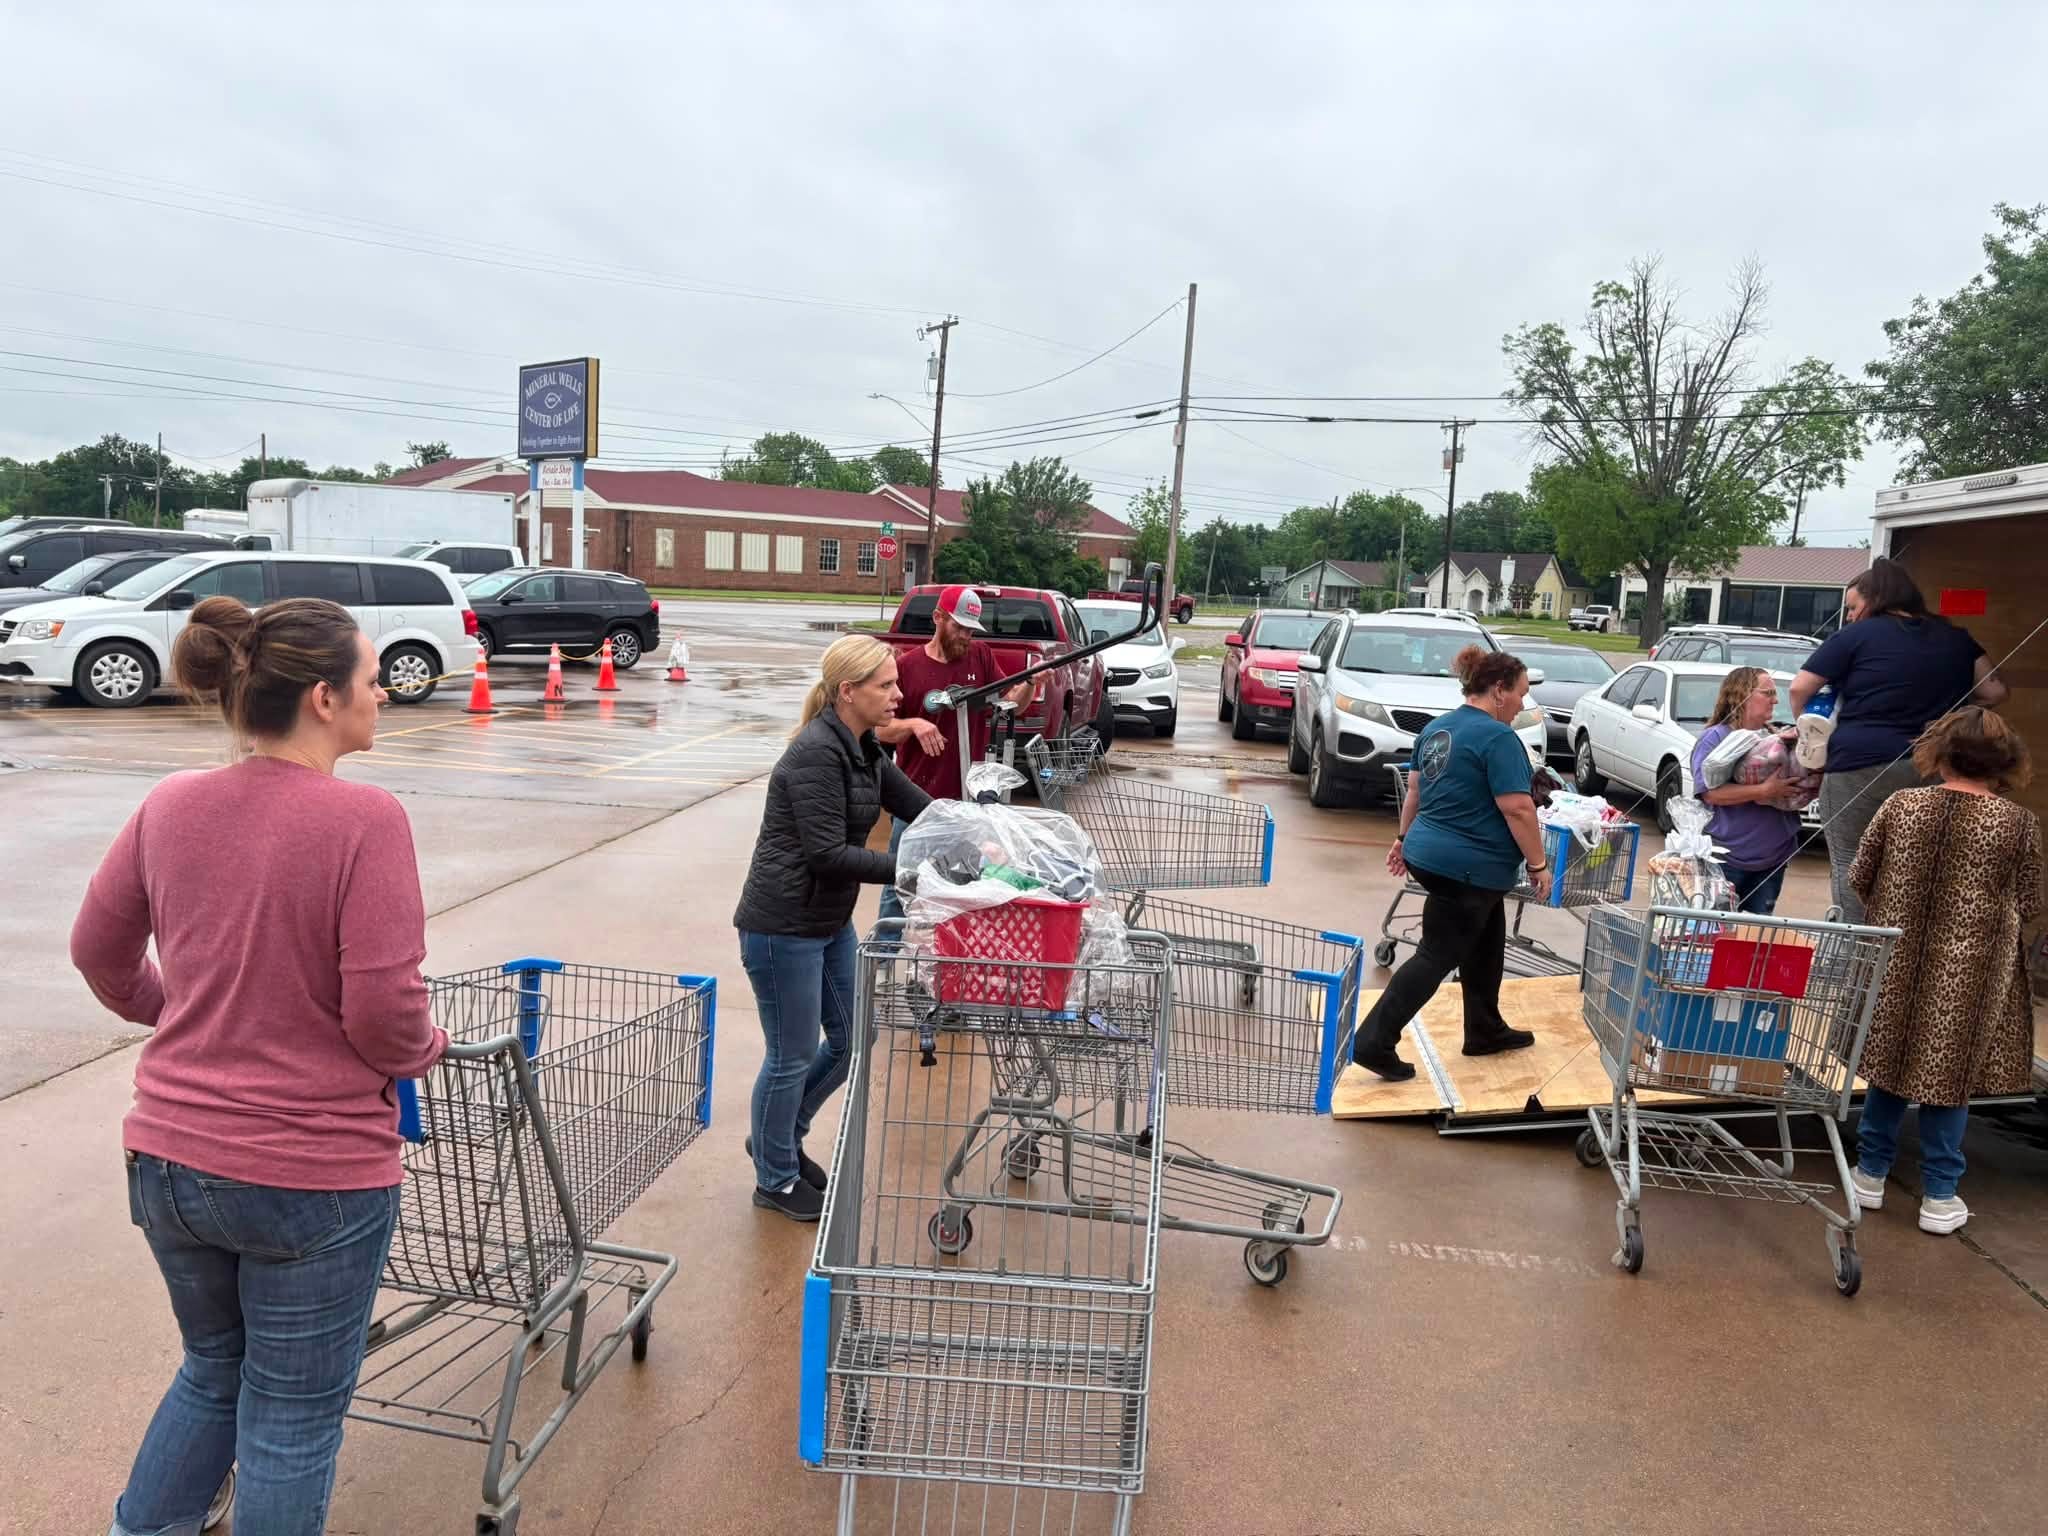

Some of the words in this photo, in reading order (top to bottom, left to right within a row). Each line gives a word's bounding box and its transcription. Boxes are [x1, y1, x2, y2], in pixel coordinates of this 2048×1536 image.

[525, 371, 557, 400] MINERAL
[559, 371, 582, 396] WELLS
[525, 406, 551, 428] CENTER
[552, 412, 562, 428] OF
[564, 401, 579, 424] LIFE
[558, 463, 572, 476] Shop
[879, 543, 896, 552] STOP
